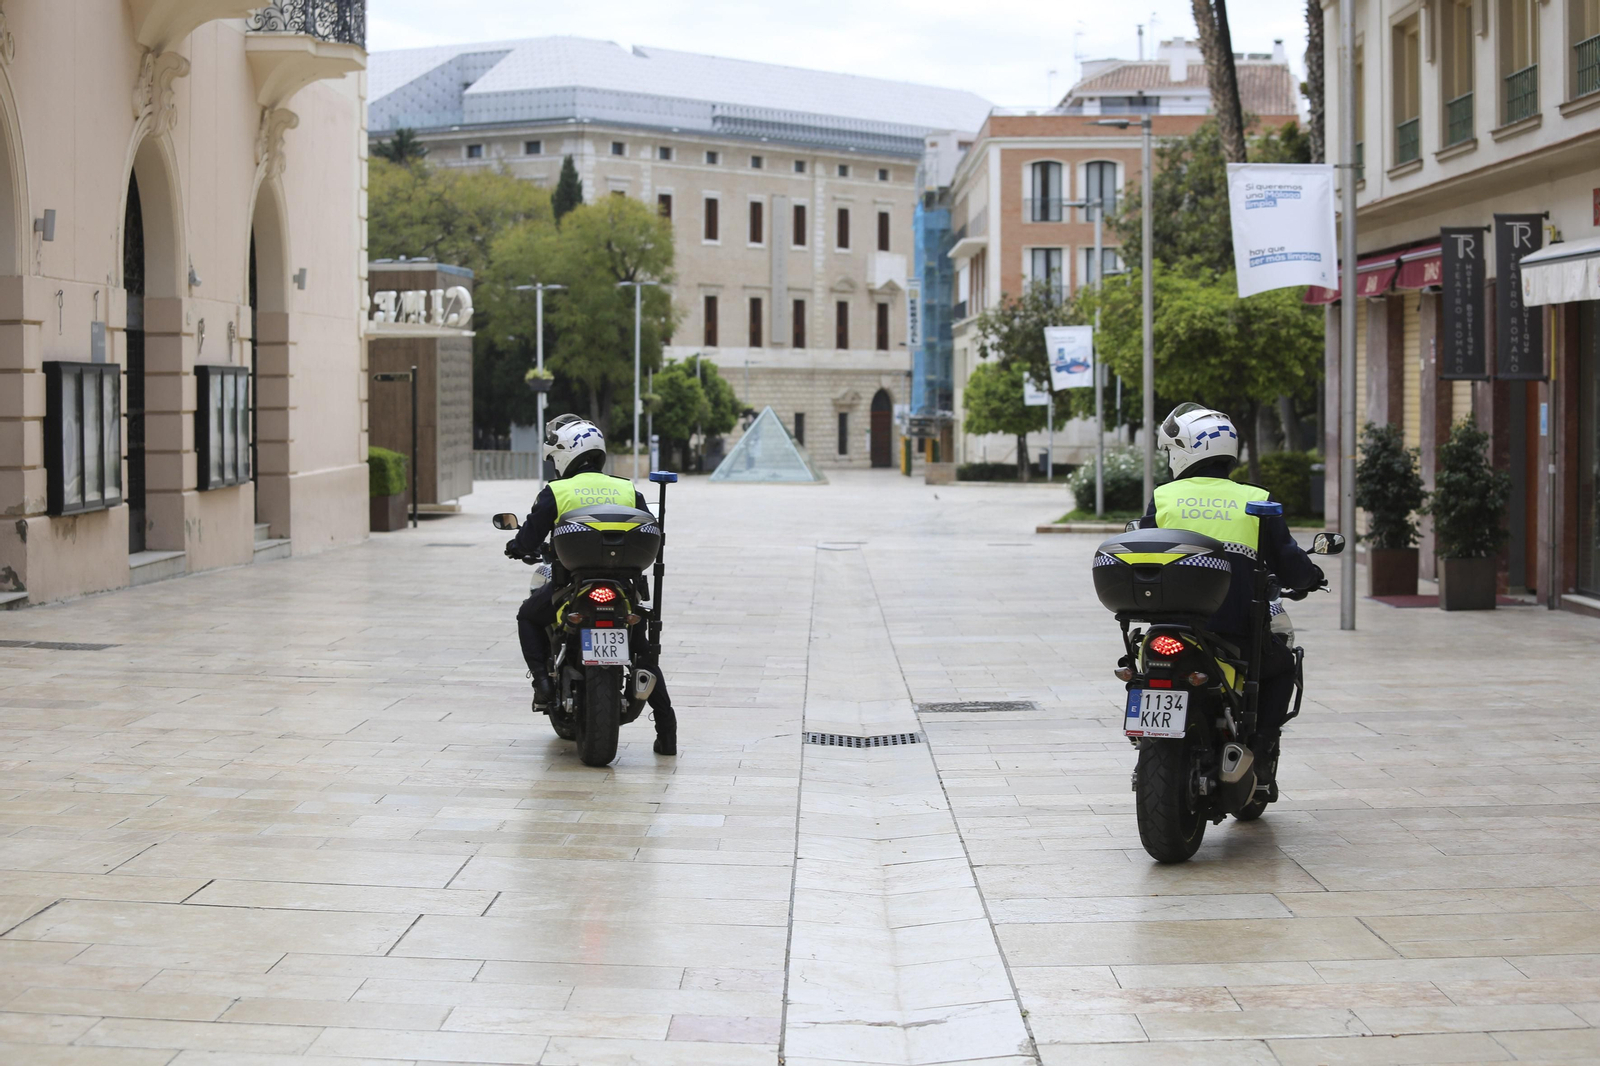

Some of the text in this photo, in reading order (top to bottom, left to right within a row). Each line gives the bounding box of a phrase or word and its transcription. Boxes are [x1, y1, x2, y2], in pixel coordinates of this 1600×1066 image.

[1245, 183, 1303, 191] Si queremos
[1249, 246, 1285, 257] hay que
[1250, 257, 1266, 267] ser
[1454, 263, 1464, 373] TEATRO ROMANO
[1510, 253, 1519, 372] TEATRO ROMANO
[1522, 305, 1530, 353] outique
[574, 487, 621, 497] POLICIA
[580, 496, 618, 505] LOCAL
[1176, 497, 1239, 509] POLICIA
[1181, 508, 1232, 521] LOCAL
[594, 632, 625, 645] 1133
[593, 645, 618, 658] KKR
[1145, 694, 1183, 711] 1134
[1140, 711, 1172, 728] KKR
